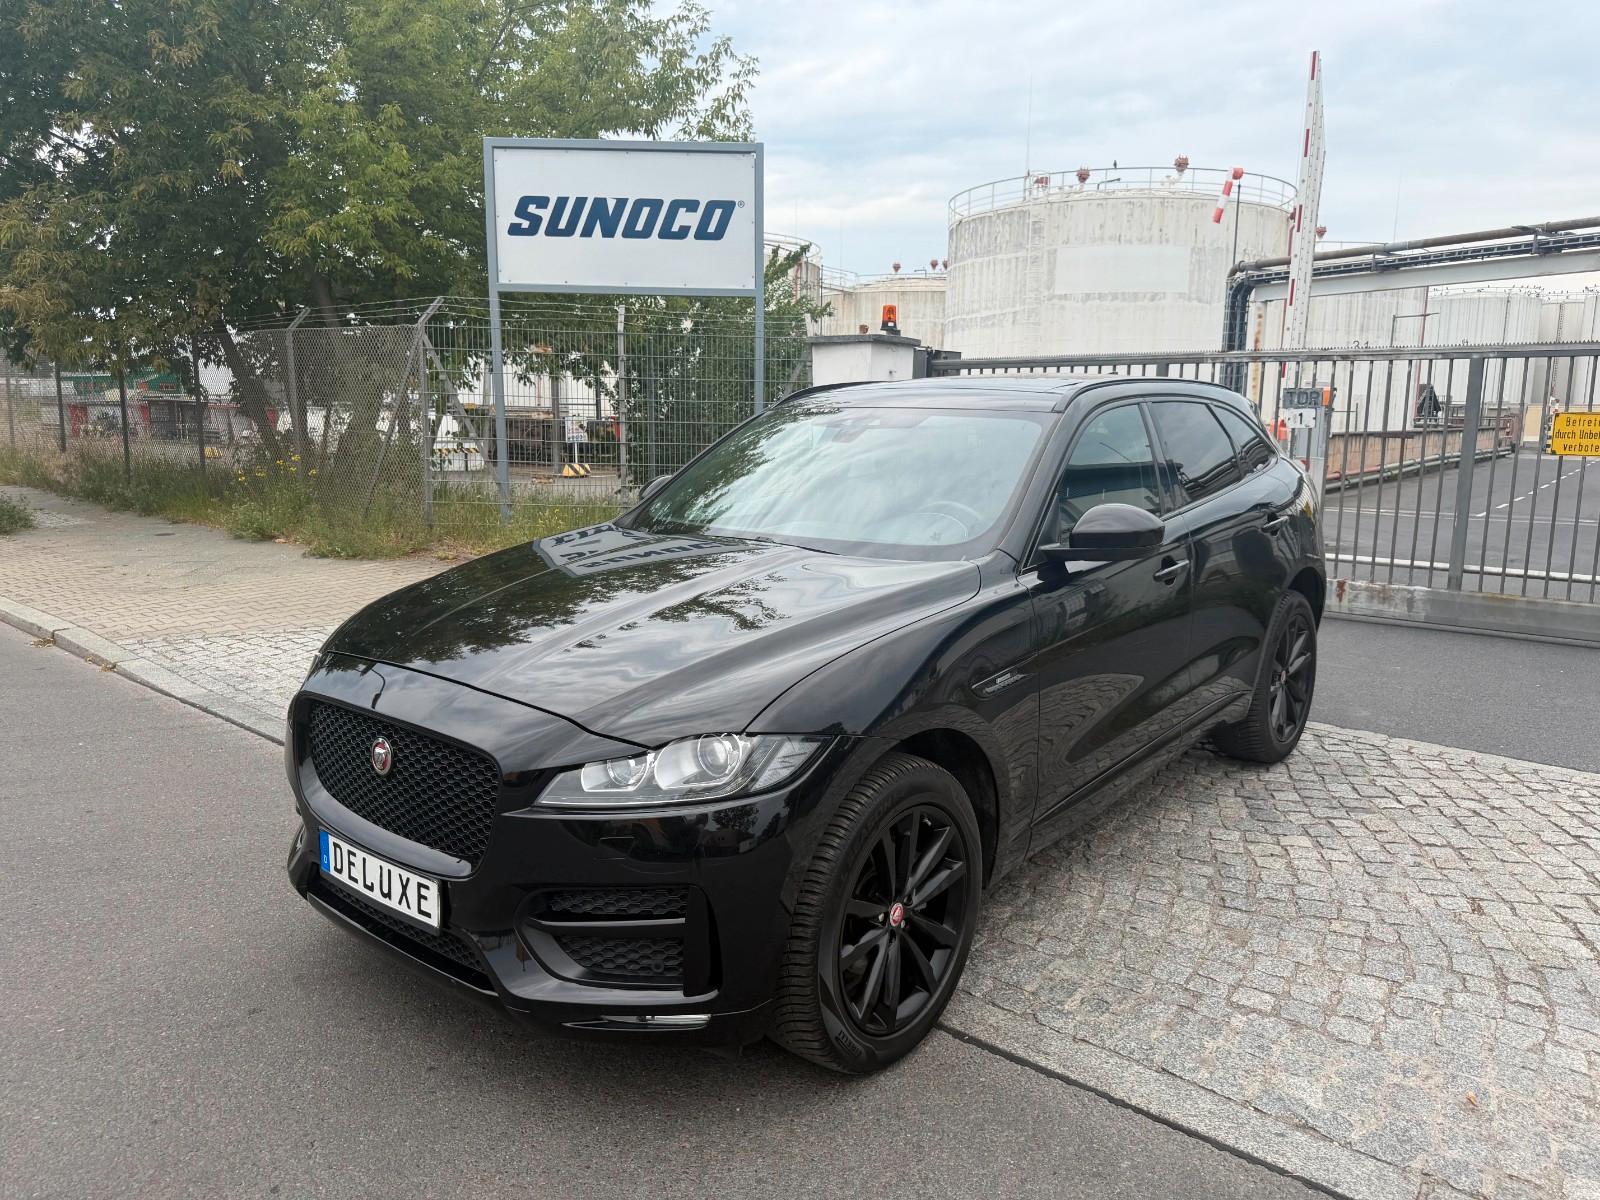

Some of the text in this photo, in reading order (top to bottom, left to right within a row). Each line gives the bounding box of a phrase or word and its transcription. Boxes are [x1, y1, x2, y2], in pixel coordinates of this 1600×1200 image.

[507, 195, 737, 241] SUNOCO
[1286, 391, 1320, 406] TOR
[1298, 412, 1303, 425] 1
[1555, 429, 1576, 439] durch
[333, 841, 432, 919] DELUXE
